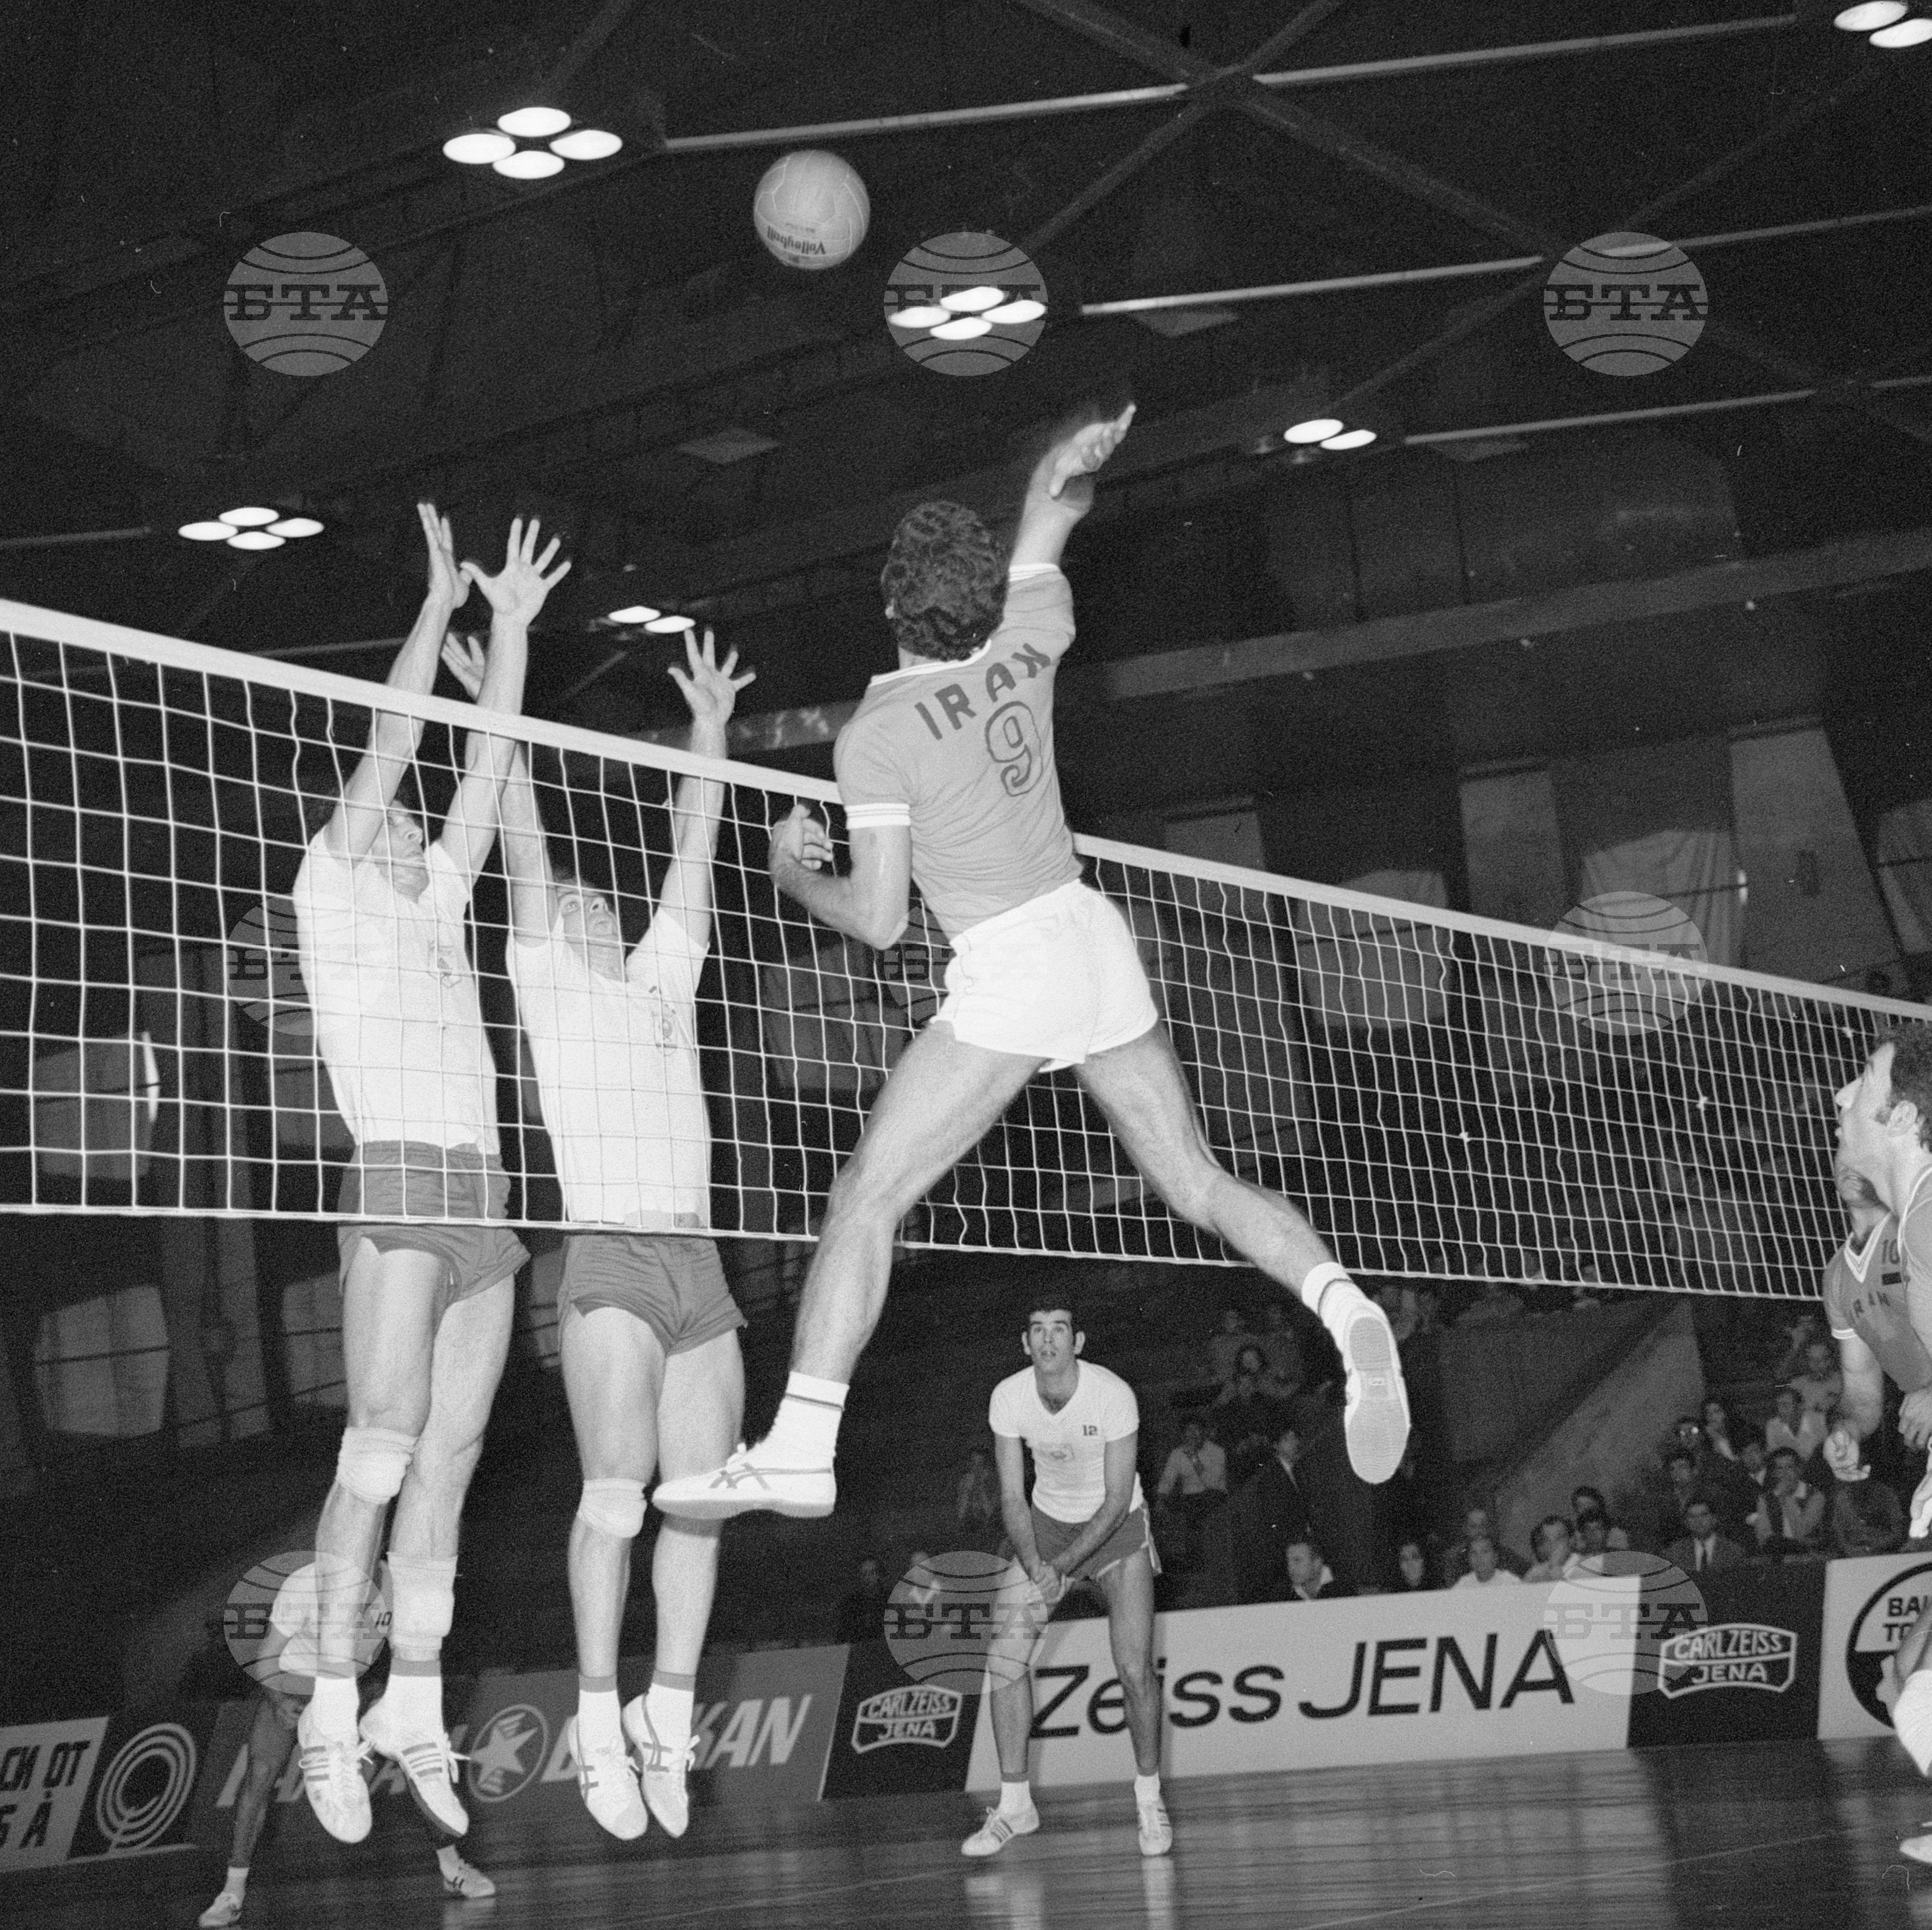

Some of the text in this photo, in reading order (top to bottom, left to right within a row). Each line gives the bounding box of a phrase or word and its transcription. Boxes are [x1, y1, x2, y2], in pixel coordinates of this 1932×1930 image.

[984, 701, 1044, 797] 9
[1083, 1425, 1098, 1436] 12
[1298, 1629, 1575, 1719] JENA
[1691, 1663, 1768, 1684] JENA
[878, 1720, 936, 1740] JENA
